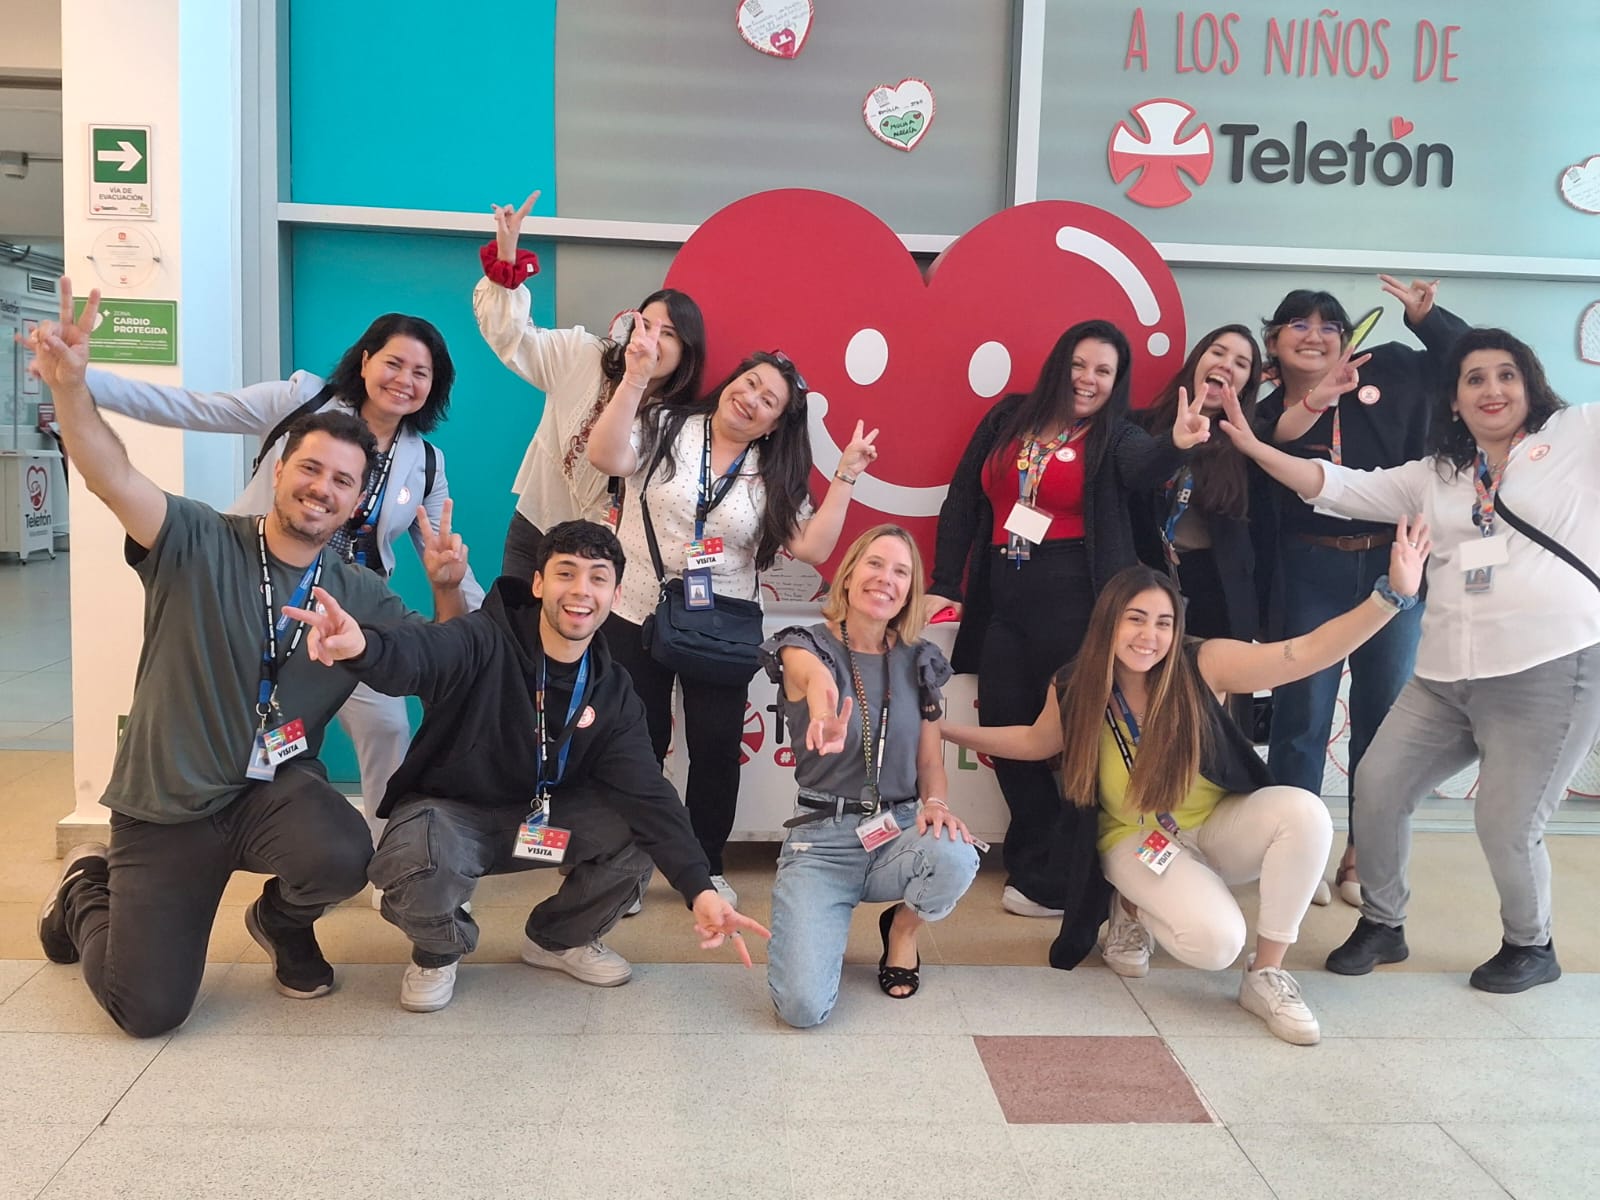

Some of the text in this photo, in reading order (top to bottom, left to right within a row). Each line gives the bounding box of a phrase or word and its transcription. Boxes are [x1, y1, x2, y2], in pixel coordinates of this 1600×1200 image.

[1124, 7, 1462, 82] A LOS NIÑOS DE
[1219, 116, 1455, 188] Teletón
[113, 317, 151, 326] CARDIO
[113, 325, 168, 335] PROTEGIDA
[696, 556, 716, 565] VISITA
[277, 743, 299, 758] VISITA
[527, 846, 553, 857] VISITA
